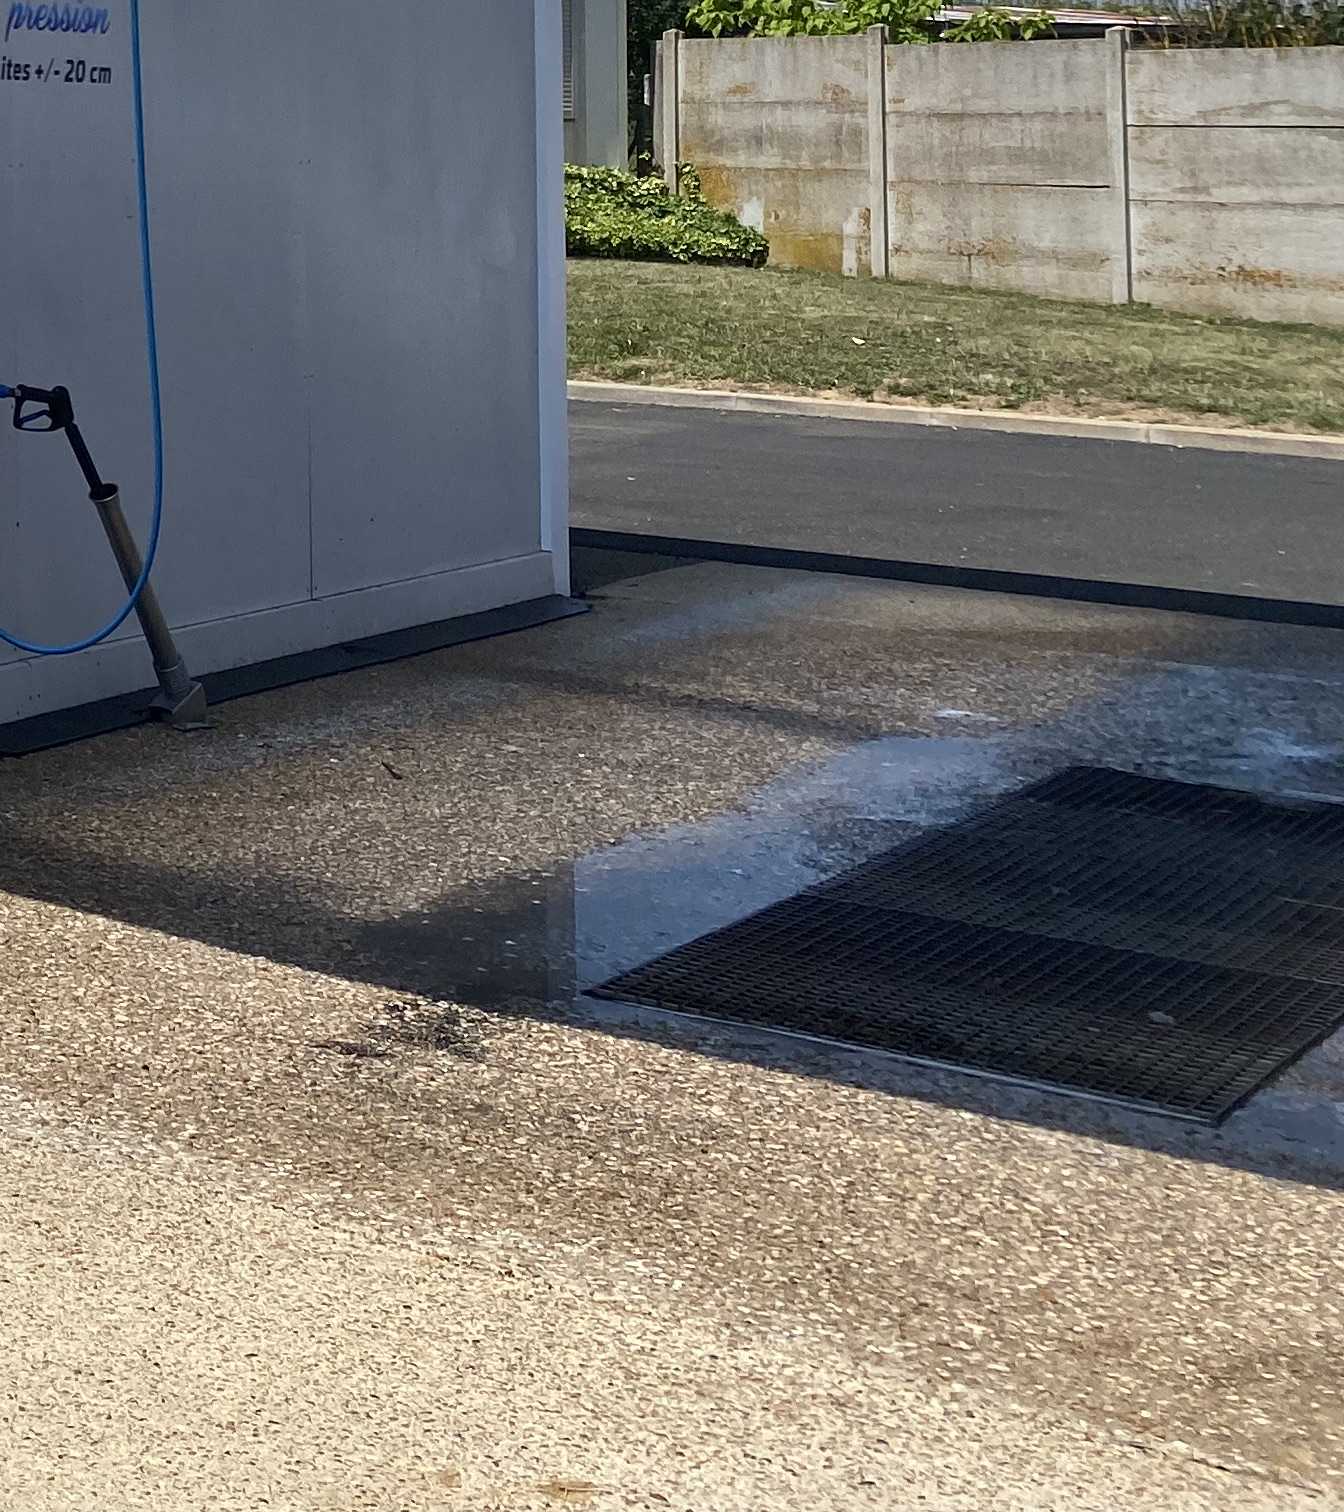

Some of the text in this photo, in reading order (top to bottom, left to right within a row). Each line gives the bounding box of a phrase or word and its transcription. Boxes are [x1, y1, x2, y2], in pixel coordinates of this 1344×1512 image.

[35, 58, 60, 83] +/-
[64, 59, 86, 83] 20
[89, 66, 111, 84] cm
